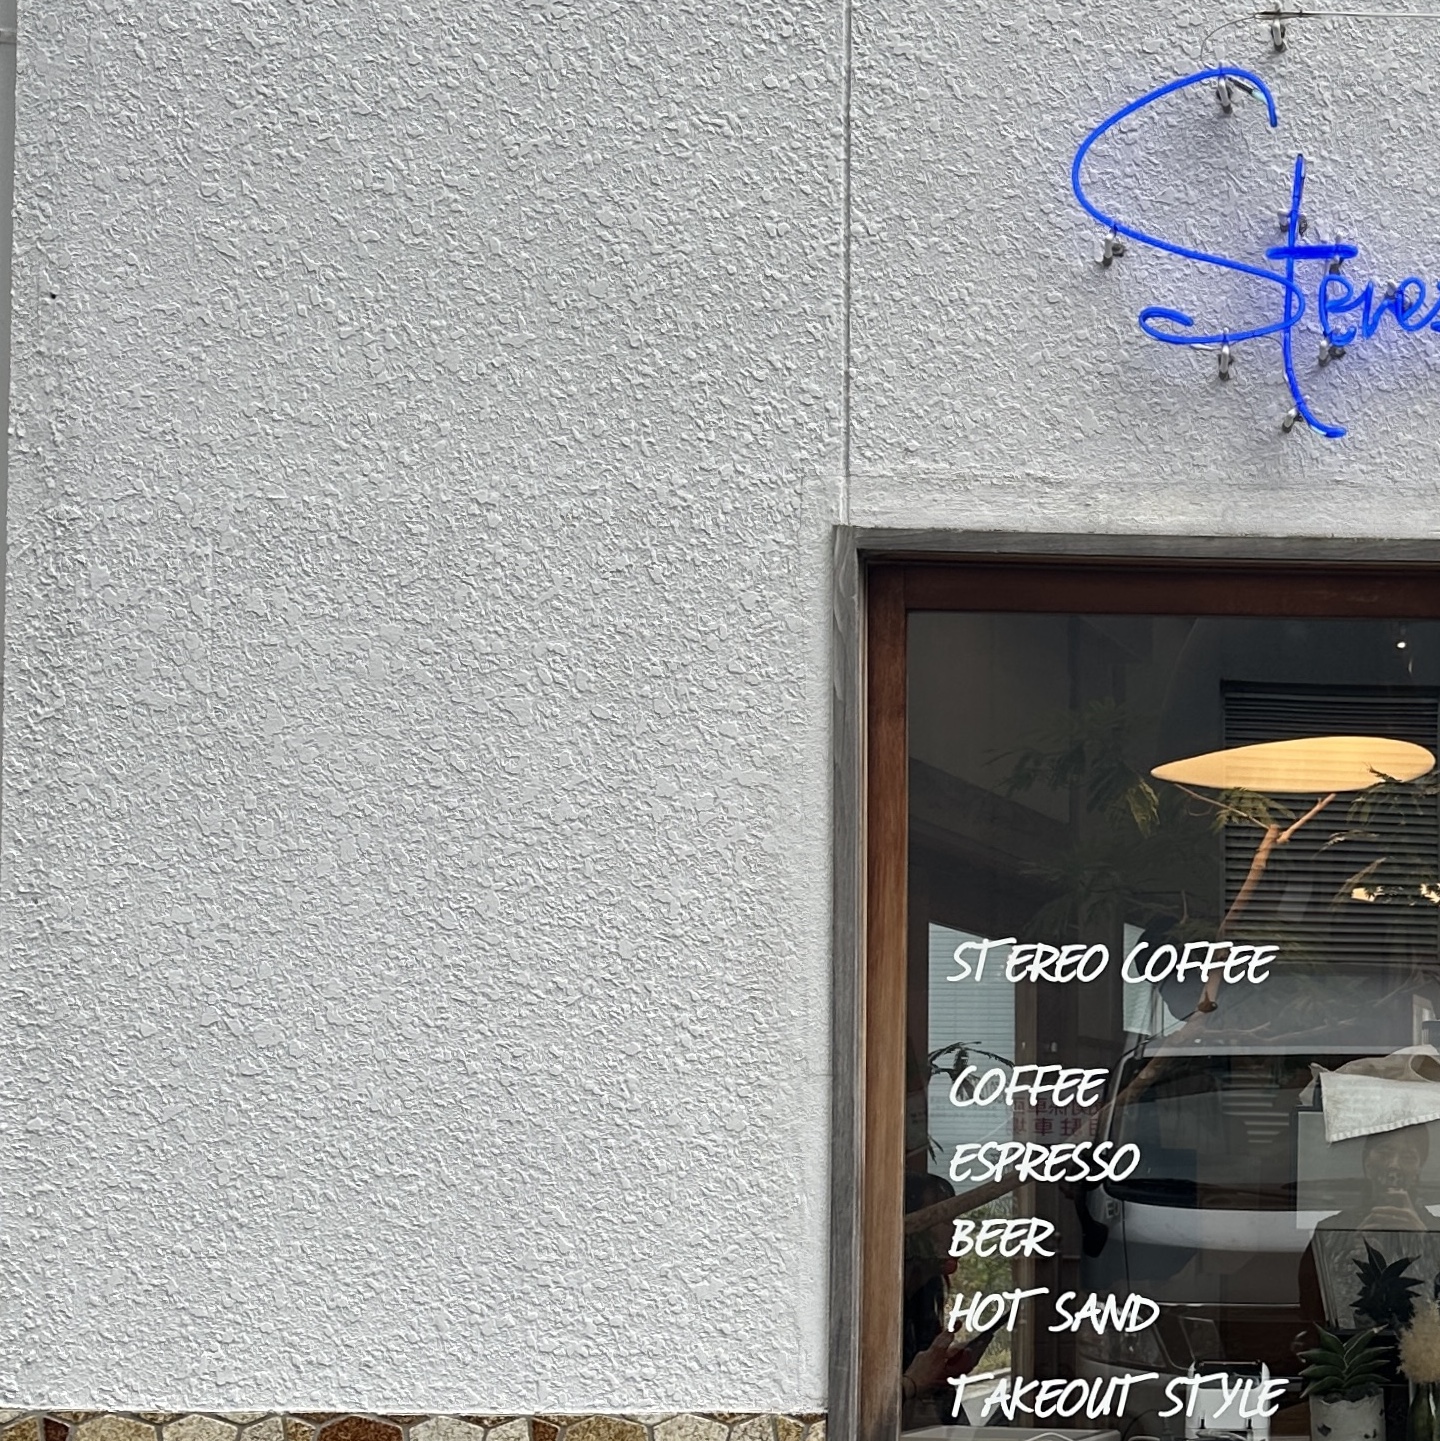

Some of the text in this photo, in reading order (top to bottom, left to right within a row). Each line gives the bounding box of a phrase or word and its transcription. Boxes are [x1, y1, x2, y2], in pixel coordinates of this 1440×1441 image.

[946, 937, 1280, 984] STEREO COFFEE
[948, 1064, 1109, 1108] COFFEE
[949, 1140, 1141, 1183] ESPRESSO
[947, 1217, 1056, 1258] BEER
[947, 1287, 1160, 1335] HOT SAND
[946, 1371, 1290, 1420] TAKEOUT STYLE
